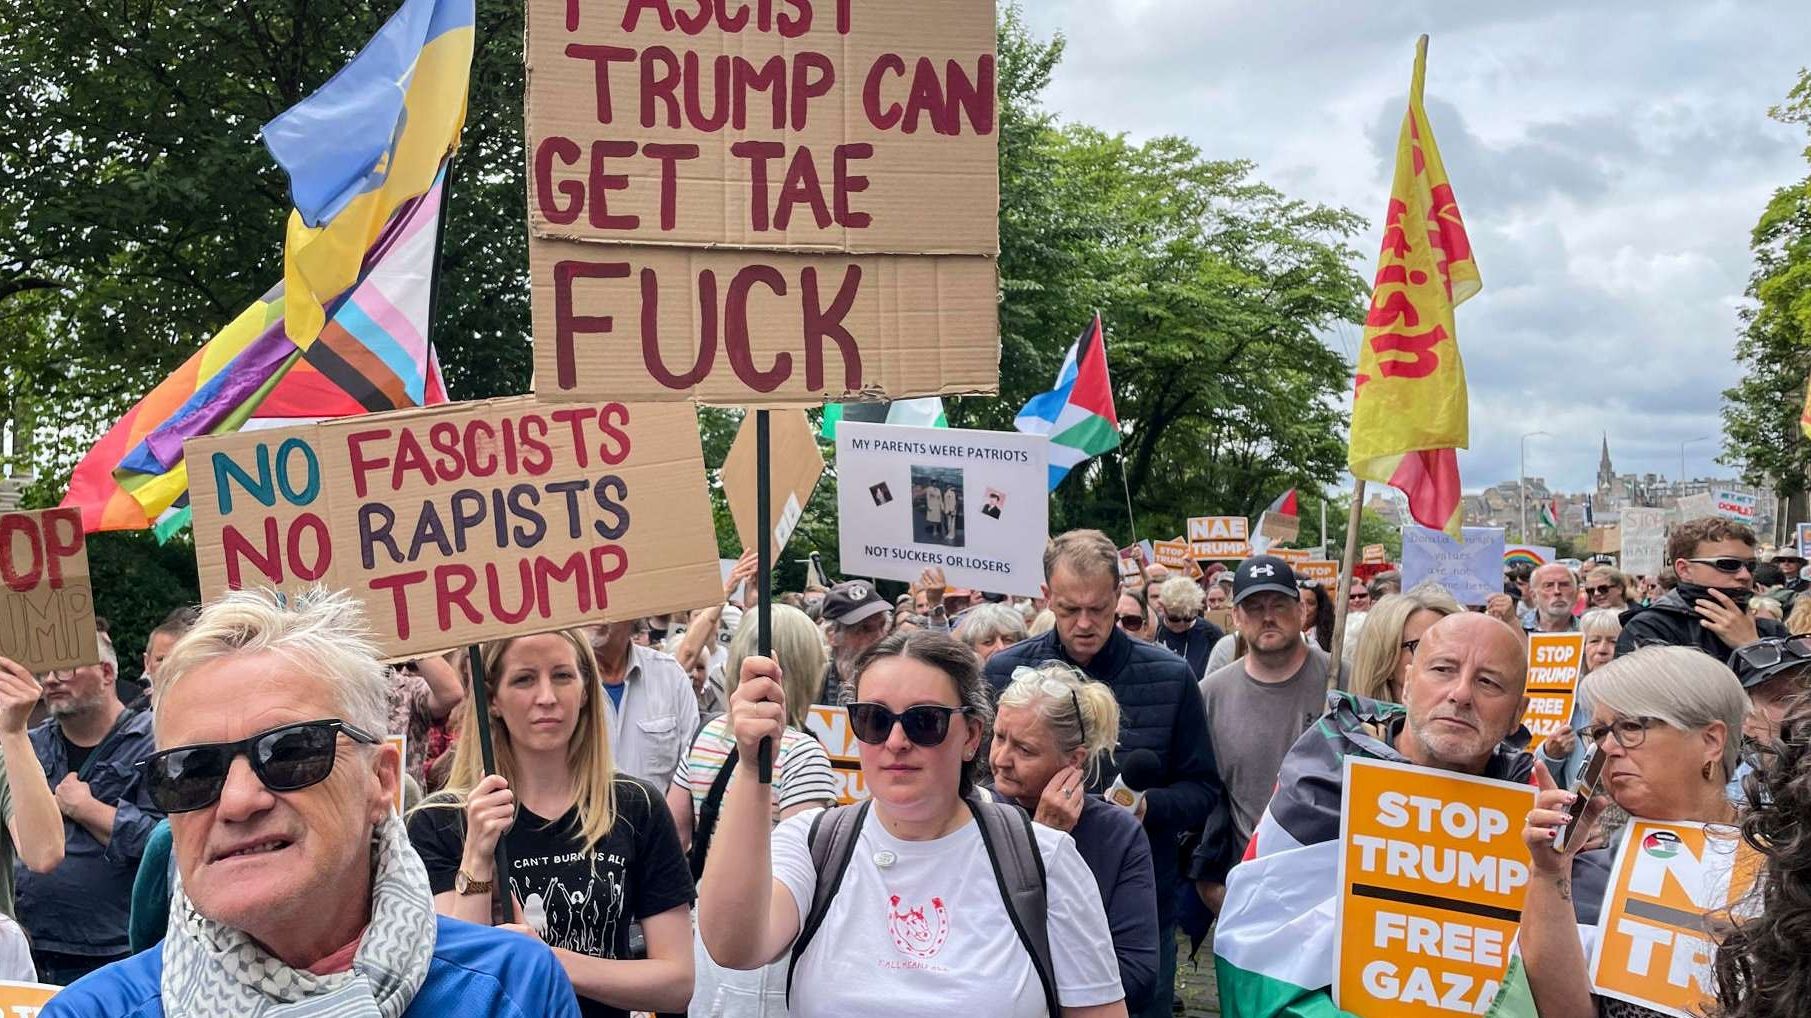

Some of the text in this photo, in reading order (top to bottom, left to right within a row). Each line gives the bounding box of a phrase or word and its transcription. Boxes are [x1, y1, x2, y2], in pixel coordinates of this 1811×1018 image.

[564, 44, 994, 136] TRUMP CAN
[535, 136, 875, 232] GET TAE
[553, 260, 863, 393] FUCK
[212, 402, 632, 515] NO FASCISTS
[851, 438, 1029, 462] MY PARENTS WERE PATRIOTS
[222, 474, 632, 590] NO RAPISTS
[1191, 519, 1246, 540] NAE
[864, 545, 1011, 574] NOT SUCKERS OR LOSERS
[1156, 555, 1184, 566] TRUM
[1160, 547, 1184, 556] STOP
[1191, 542, 1246, 554] TRUMP
[368, 544, 630, 641] TRUMP
[1536, 645, 1575, 663] STOP
[1530, 667, 1577, 684] TRUMP
[1527, 697, 1565, 715] FREE
[1375, 791, 1510, 844] STOP
[514, 856, 549, 869] CAN'T
[553, 852, 586, 864] BURN
[1352, 833, 1530, 896] TRUMP
[1374, 911, 1504, 968] FREE
